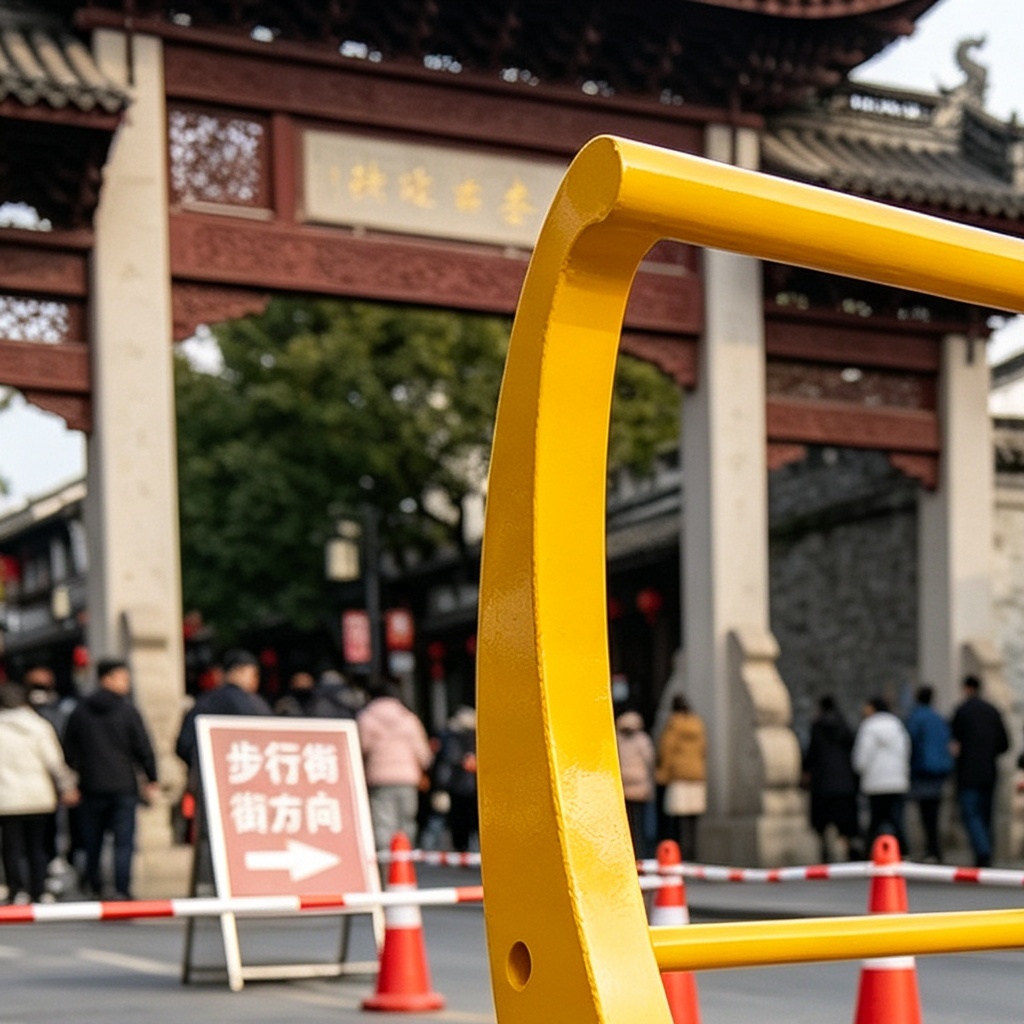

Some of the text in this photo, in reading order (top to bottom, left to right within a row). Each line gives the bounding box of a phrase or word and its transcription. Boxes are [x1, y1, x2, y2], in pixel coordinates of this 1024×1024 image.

[226, 740, 339, 785] 步行街
[229, 791, 343, 835] 街方向
